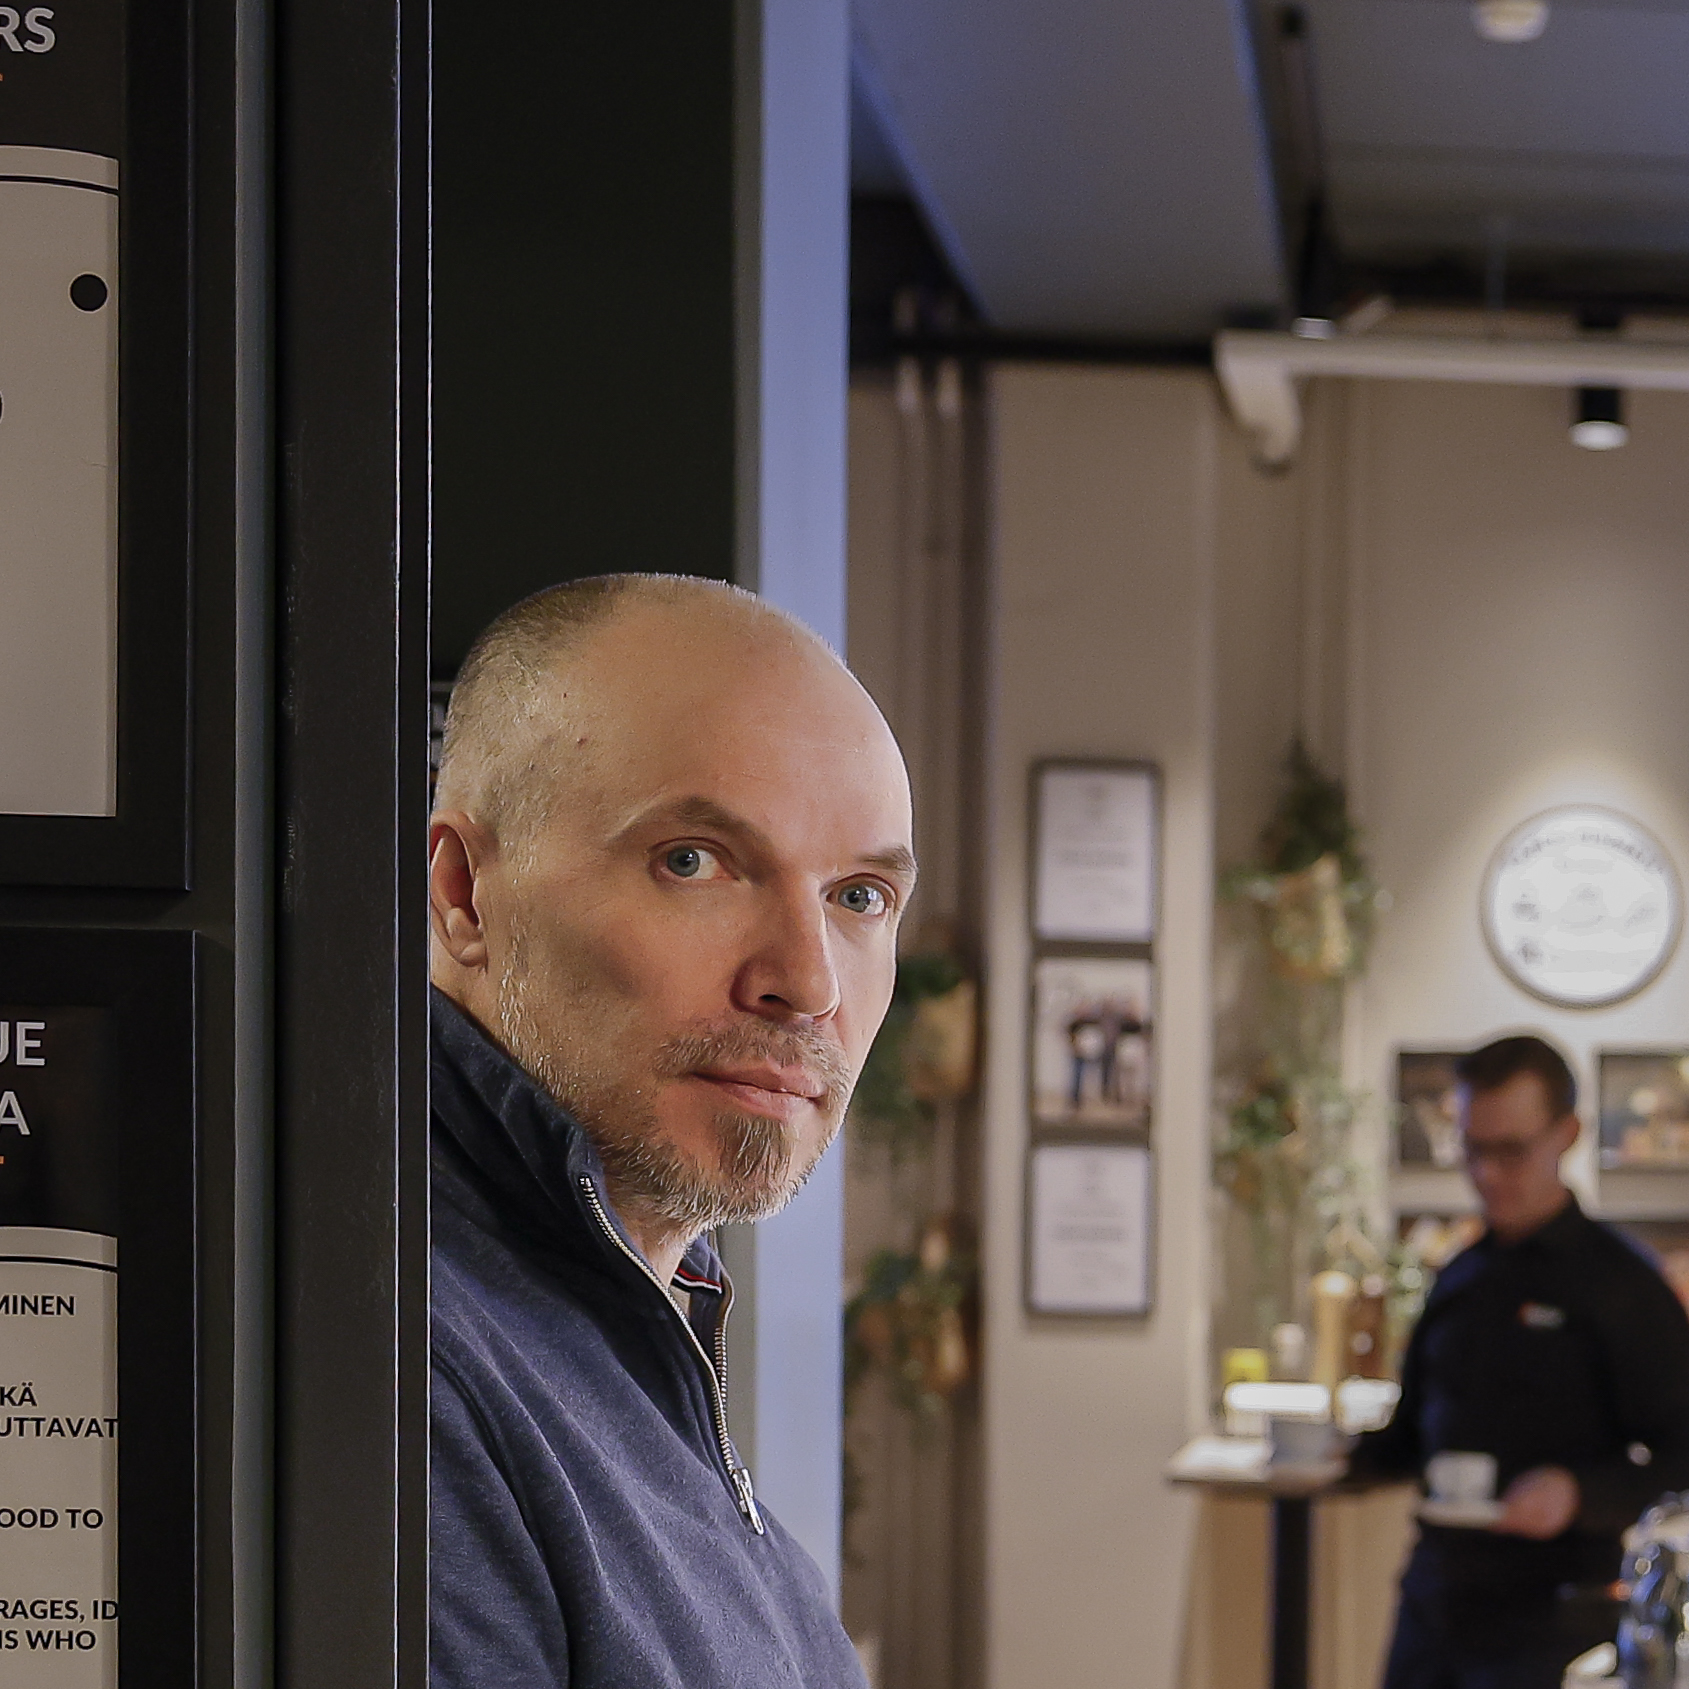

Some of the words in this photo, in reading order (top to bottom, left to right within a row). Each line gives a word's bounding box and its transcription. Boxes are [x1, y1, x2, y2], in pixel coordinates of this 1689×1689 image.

[65, 1508, 104, 1529] TO
[92, 1600, 119, 1620] ID
[25, 1630, 97, 1651] WHO
